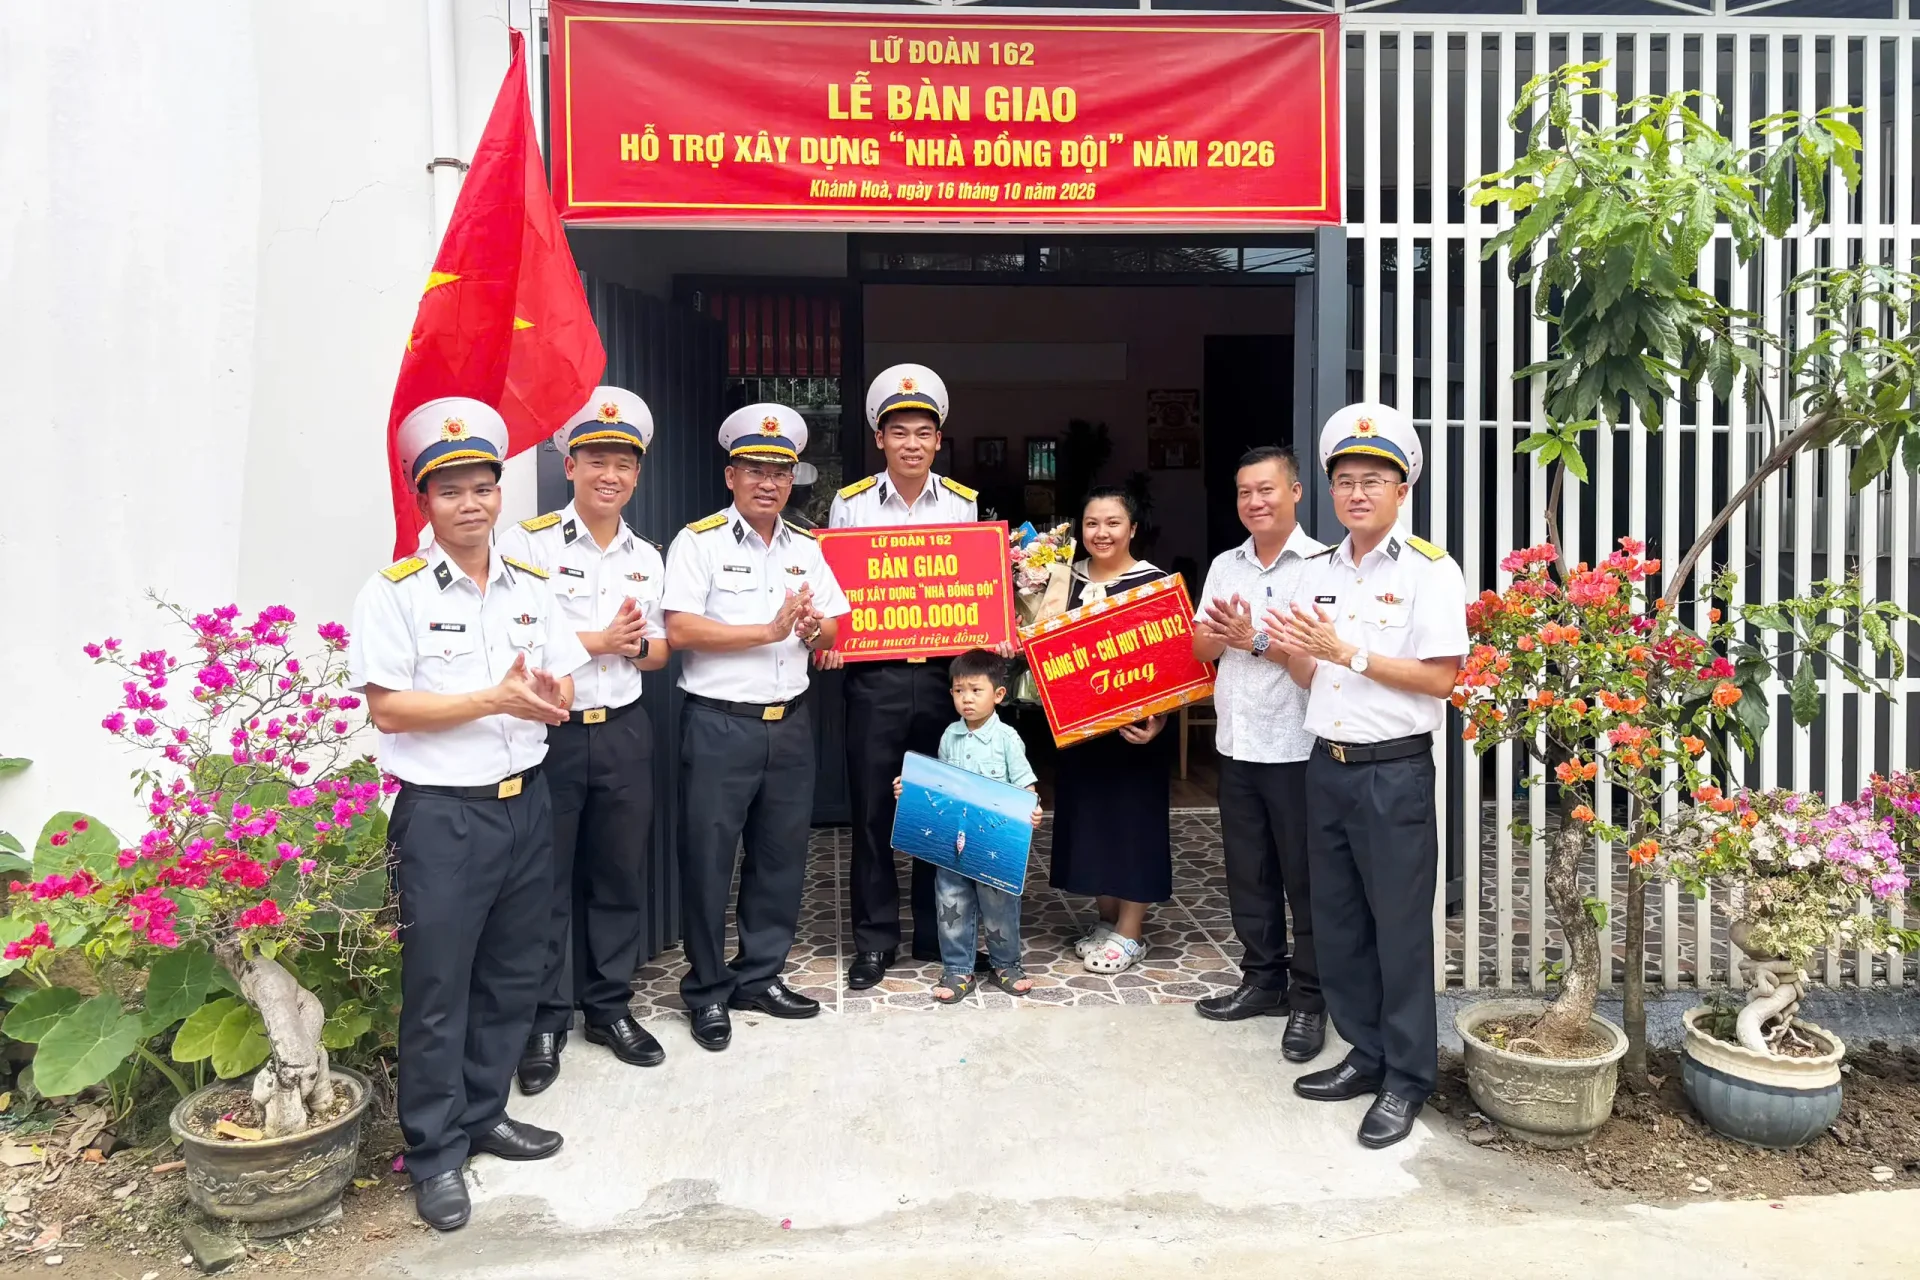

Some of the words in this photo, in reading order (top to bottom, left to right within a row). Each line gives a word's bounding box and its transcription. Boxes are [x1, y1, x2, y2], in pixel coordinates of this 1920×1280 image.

[870, 35, 904, 63] LỮ
[909, 36, 980, 65] ĐOÀN
[989, 42, 1035, 66] 162
[828, 70, 873, 120] LỄ
[887, 77, 971, 121] BÀN
[985, 86, 1077, 122] GIAO
[620, 123, 660, 161] HỖ
[668, 132, 725, 169] TRỢ
[734, 130, 791, 163] XÂY
[800, 135, 880, 171] DỰNG
[973, 130, 1052, 167] ĐỒNG
[1133, 135, 1198, 167] NĂM
[1207, 140, 1275, 168] 2026
[810, 179, 856, 198] Khánh
[860, 180, 893, 200] Hoà,
[897, 181, 933, 201] ngày
[937, 182, 954, 199] 16
[958, 182, 999, 202] tháng
[1004, 183, 1020, 200] 10
[1024, 182, 1056, 200] năm
[1059, 182, 1096, 201] 2026
[871, 535, 888, 549] LỮ
[890, 533, 925, 548] ĐOÀN
[929, 534, 952, 546] 162
[867, 552, 908, 580] BÀN
[913, 554, 958, 578] GIAO
[844, 588, 864, 606] TRỢ
[866, 585, 886, 602] XÂY
[888, 585, 917, 603] DỰNG
[851, 602, 979, 632] 80.000.000đ
[844, 636, 879, 650] (Tám
[882, 634, 917, 647] mươi
[920, 633, 950, 648] triệu
[953, 628, 989, 645] đồng)
[1042, 651, 1076, 682] ĐẢNG
[1072, 642, 1090, 670] ỦY
[1096, 630, 1119, 662] CHỈ
[1115, 628, 1141, 655] HUY
[1138, 620, 1164, 646] TÀU
[1161, 613, 1186, 639] 012
[1090, 662, 1158, 695] Tặng
